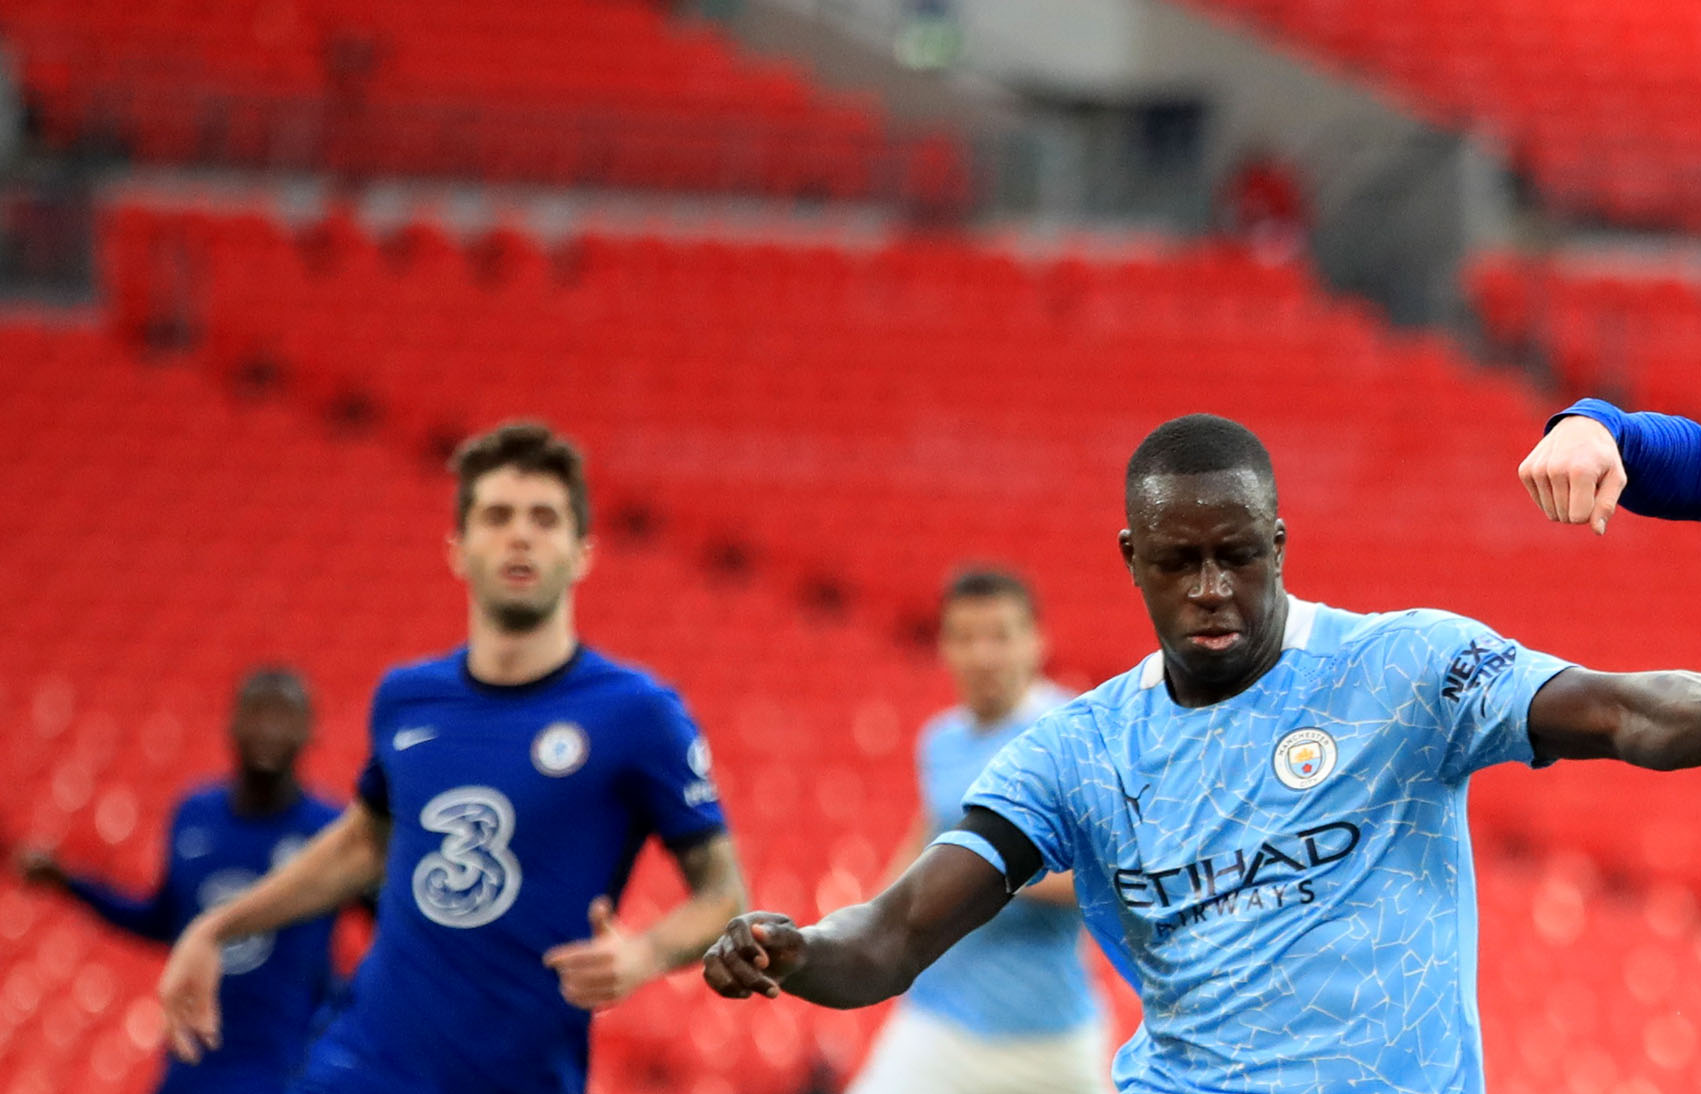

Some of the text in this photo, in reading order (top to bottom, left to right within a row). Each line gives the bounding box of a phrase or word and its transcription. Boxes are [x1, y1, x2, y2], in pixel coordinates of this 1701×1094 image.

[1441, 636, 1502, 703] NEX
[1278, 731, 1330, 756] MANCHESTER
[412, 785, 523, 929] 3
[1114, 821, 1360, 908] ETIHAD
[1155, 880, 1315, 937] AIRWAYS
